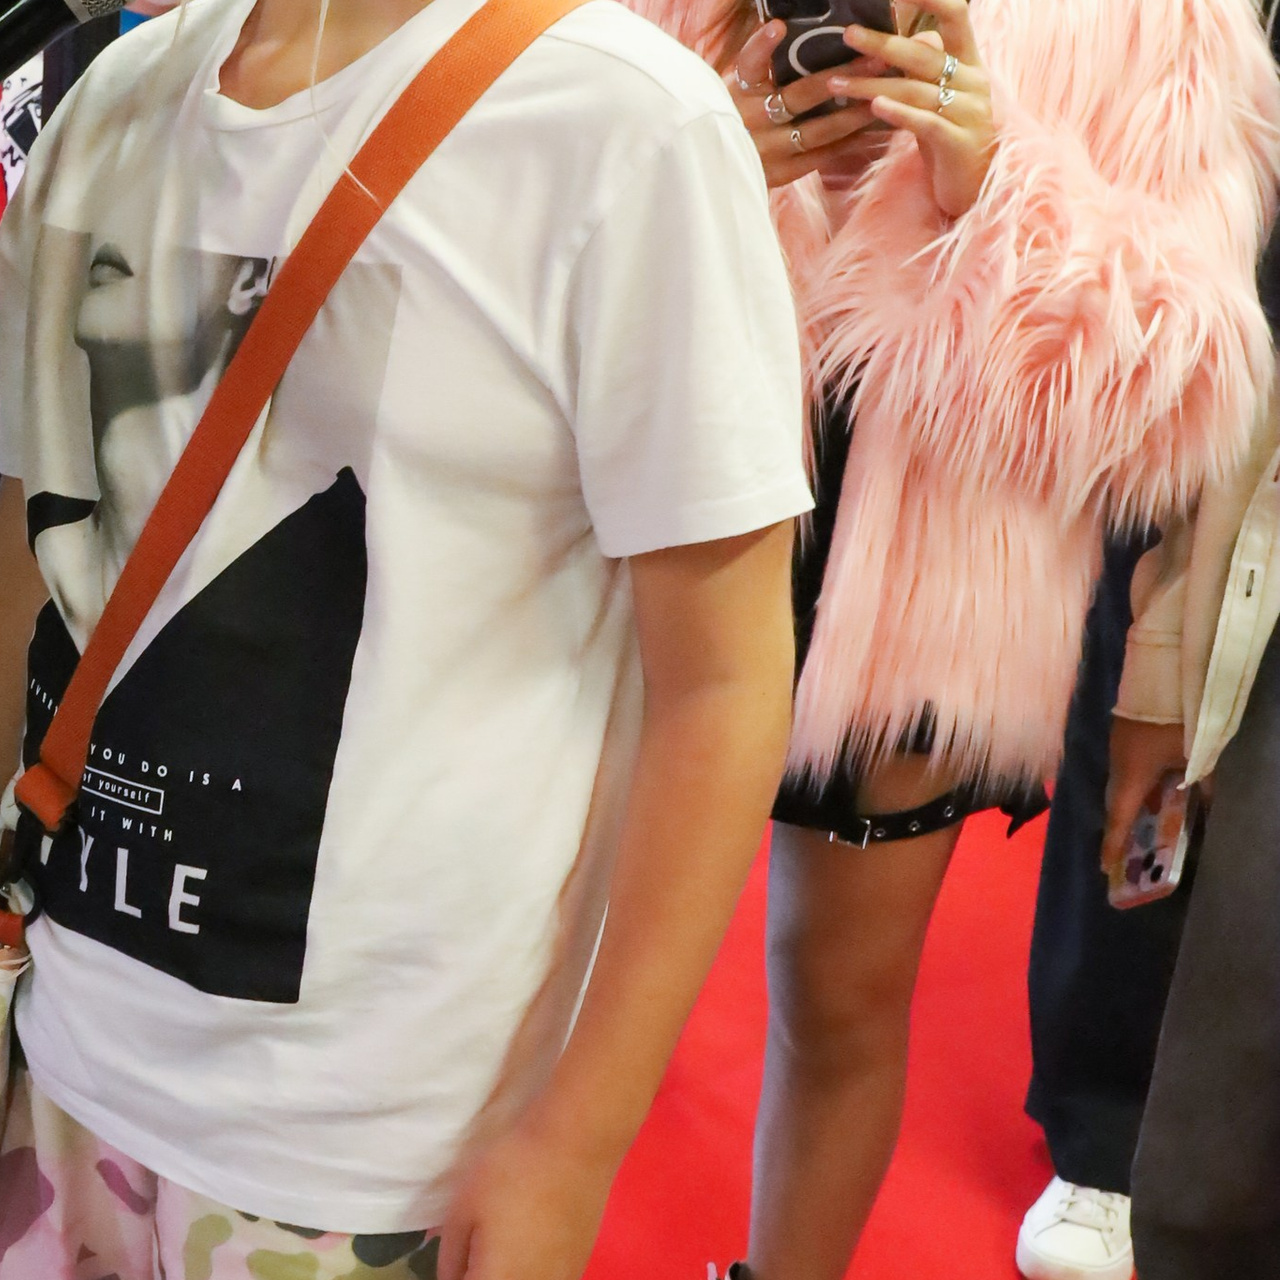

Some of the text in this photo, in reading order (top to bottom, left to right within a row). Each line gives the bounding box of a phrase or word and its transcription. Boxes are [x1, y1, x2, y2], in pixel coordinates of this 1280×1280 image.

[90, 742, 125, 765] YOU
[141, 760, 168, 778] DO
[189, 770, 210, 786] IS
[231, 778, 242, 792] A
[98, 779, 150, 803] yourself
[91, 805, 173, 842] IT WITH
[40, 825, 208, 935] YLE
